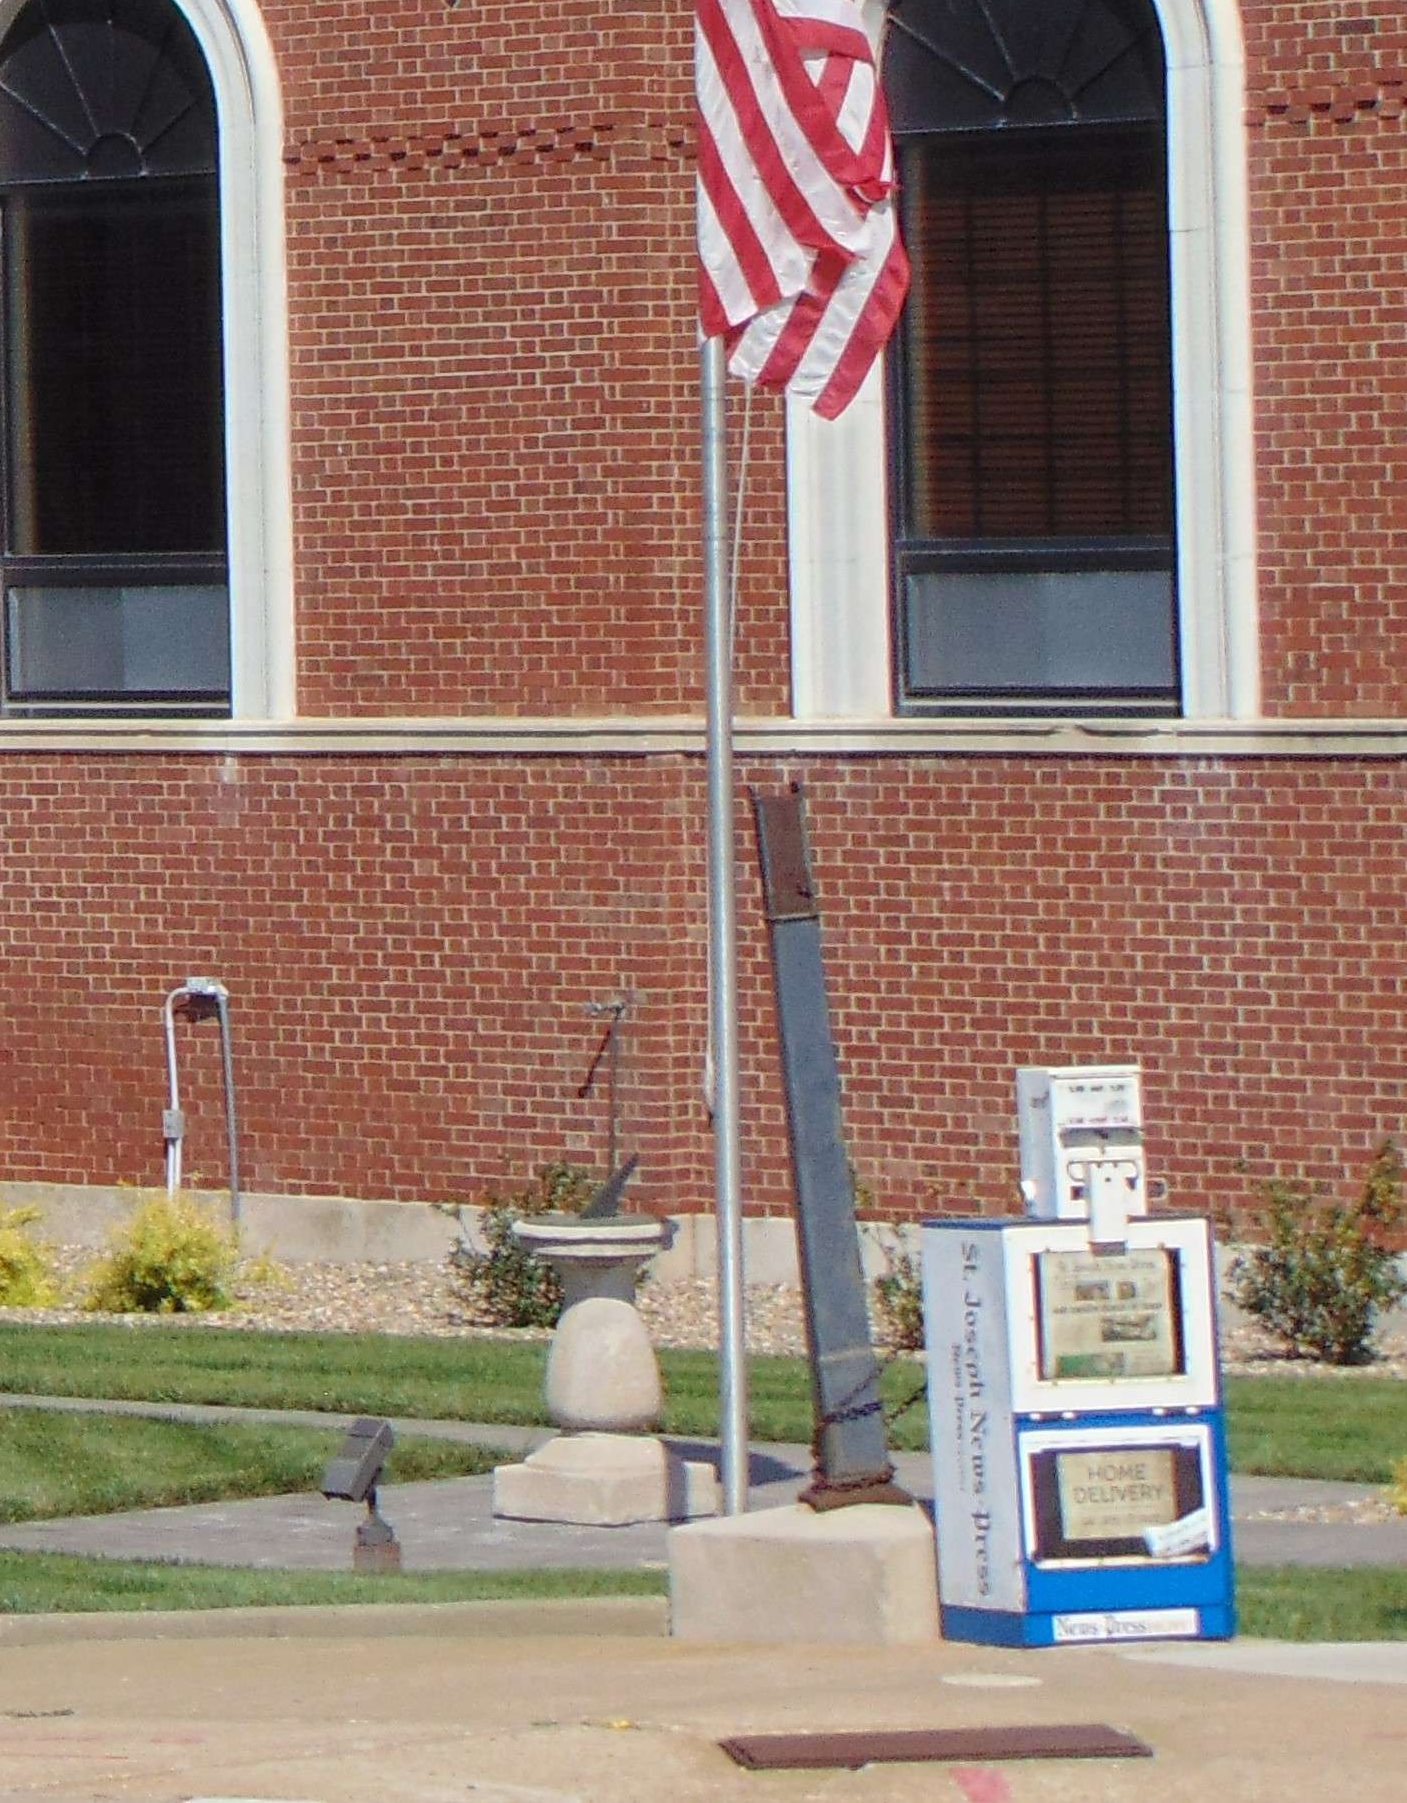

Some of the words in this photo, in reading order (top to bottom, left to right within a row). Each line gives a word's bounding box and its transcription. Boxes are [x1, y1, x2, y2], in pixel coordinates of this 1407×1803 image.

[964, 1291, 985, 1398] Joseph
[1088, 1462, 1146, 1481] HOME
[1072, 1484, 1164, 1504] DELIVERY
